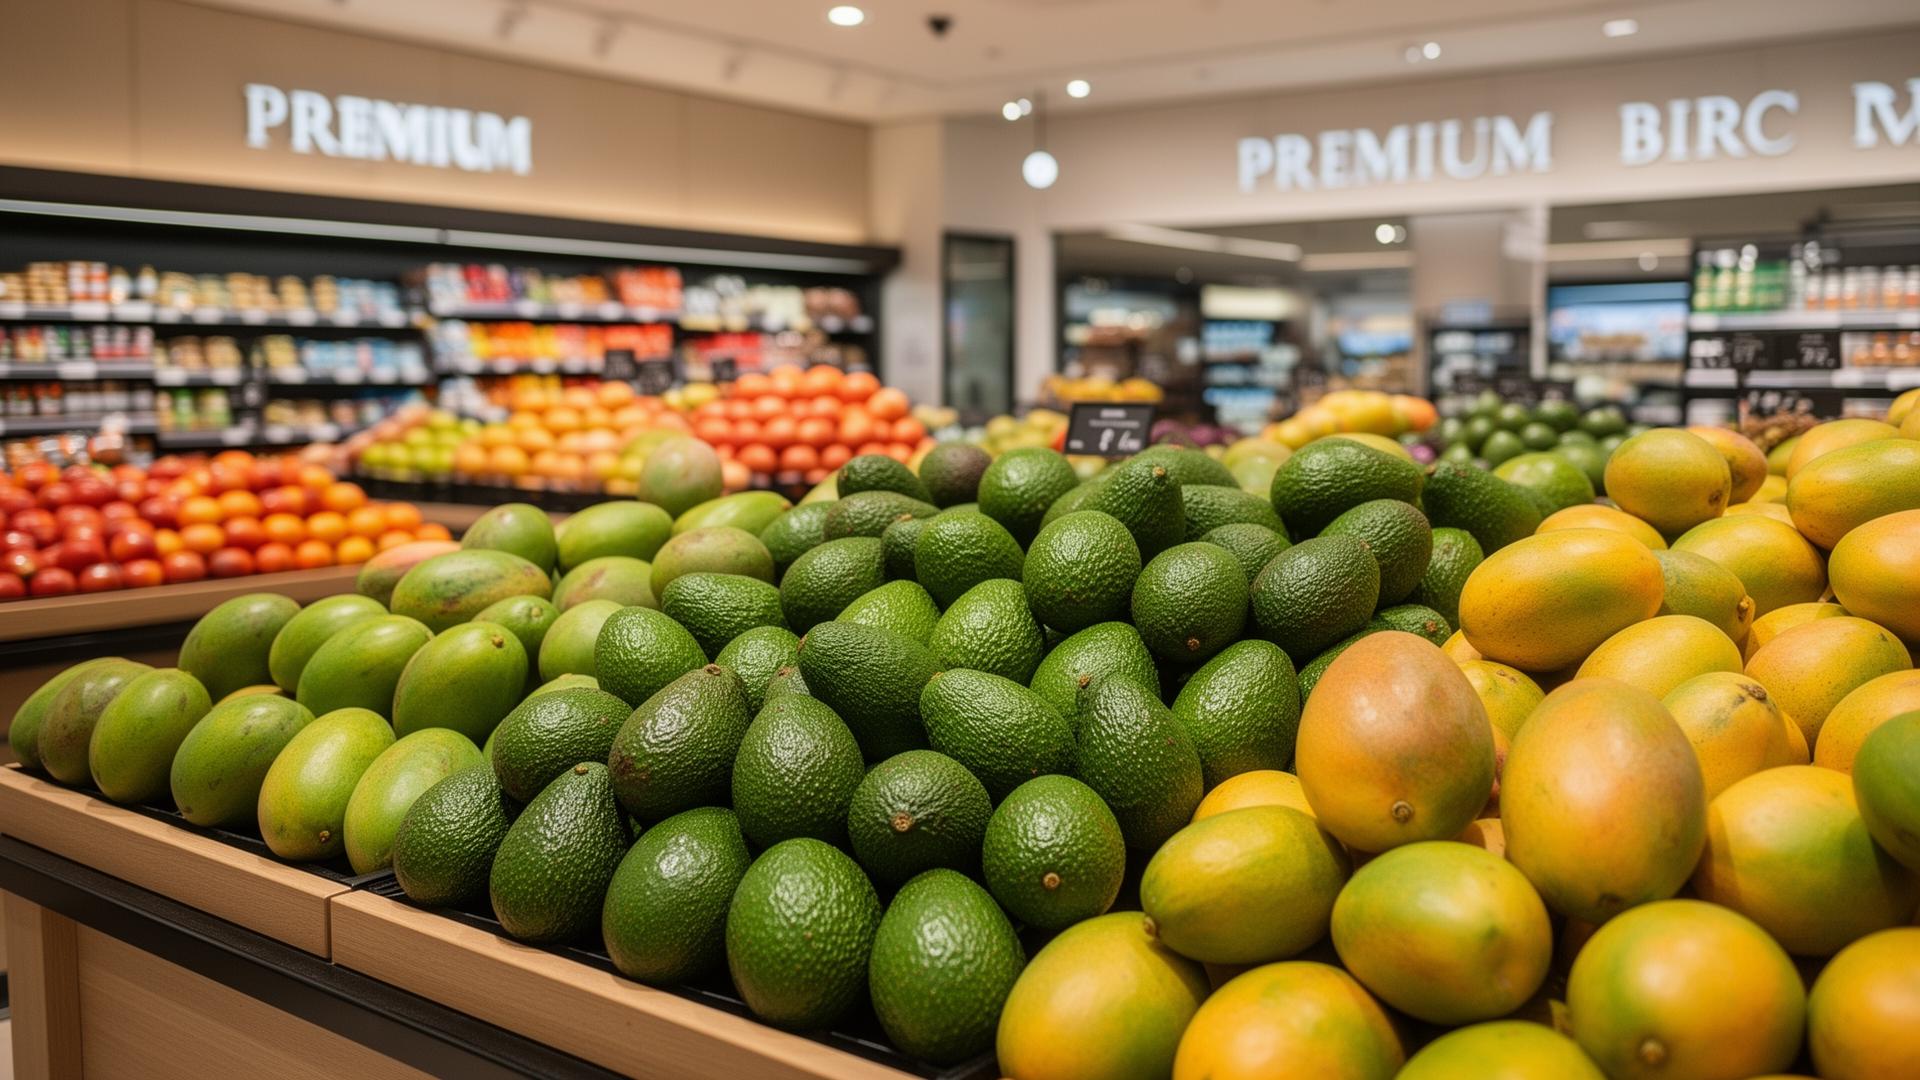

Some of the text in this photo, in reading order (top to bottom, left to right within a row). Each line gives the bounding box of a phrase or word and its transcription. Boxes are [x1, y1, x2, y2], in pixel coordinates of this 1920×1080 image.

[245, 83, 533, 176] PREMIUM
[1237, 111, 1554, 192] PREMIUM
[1619, 89, 1798, 167] BIRC
